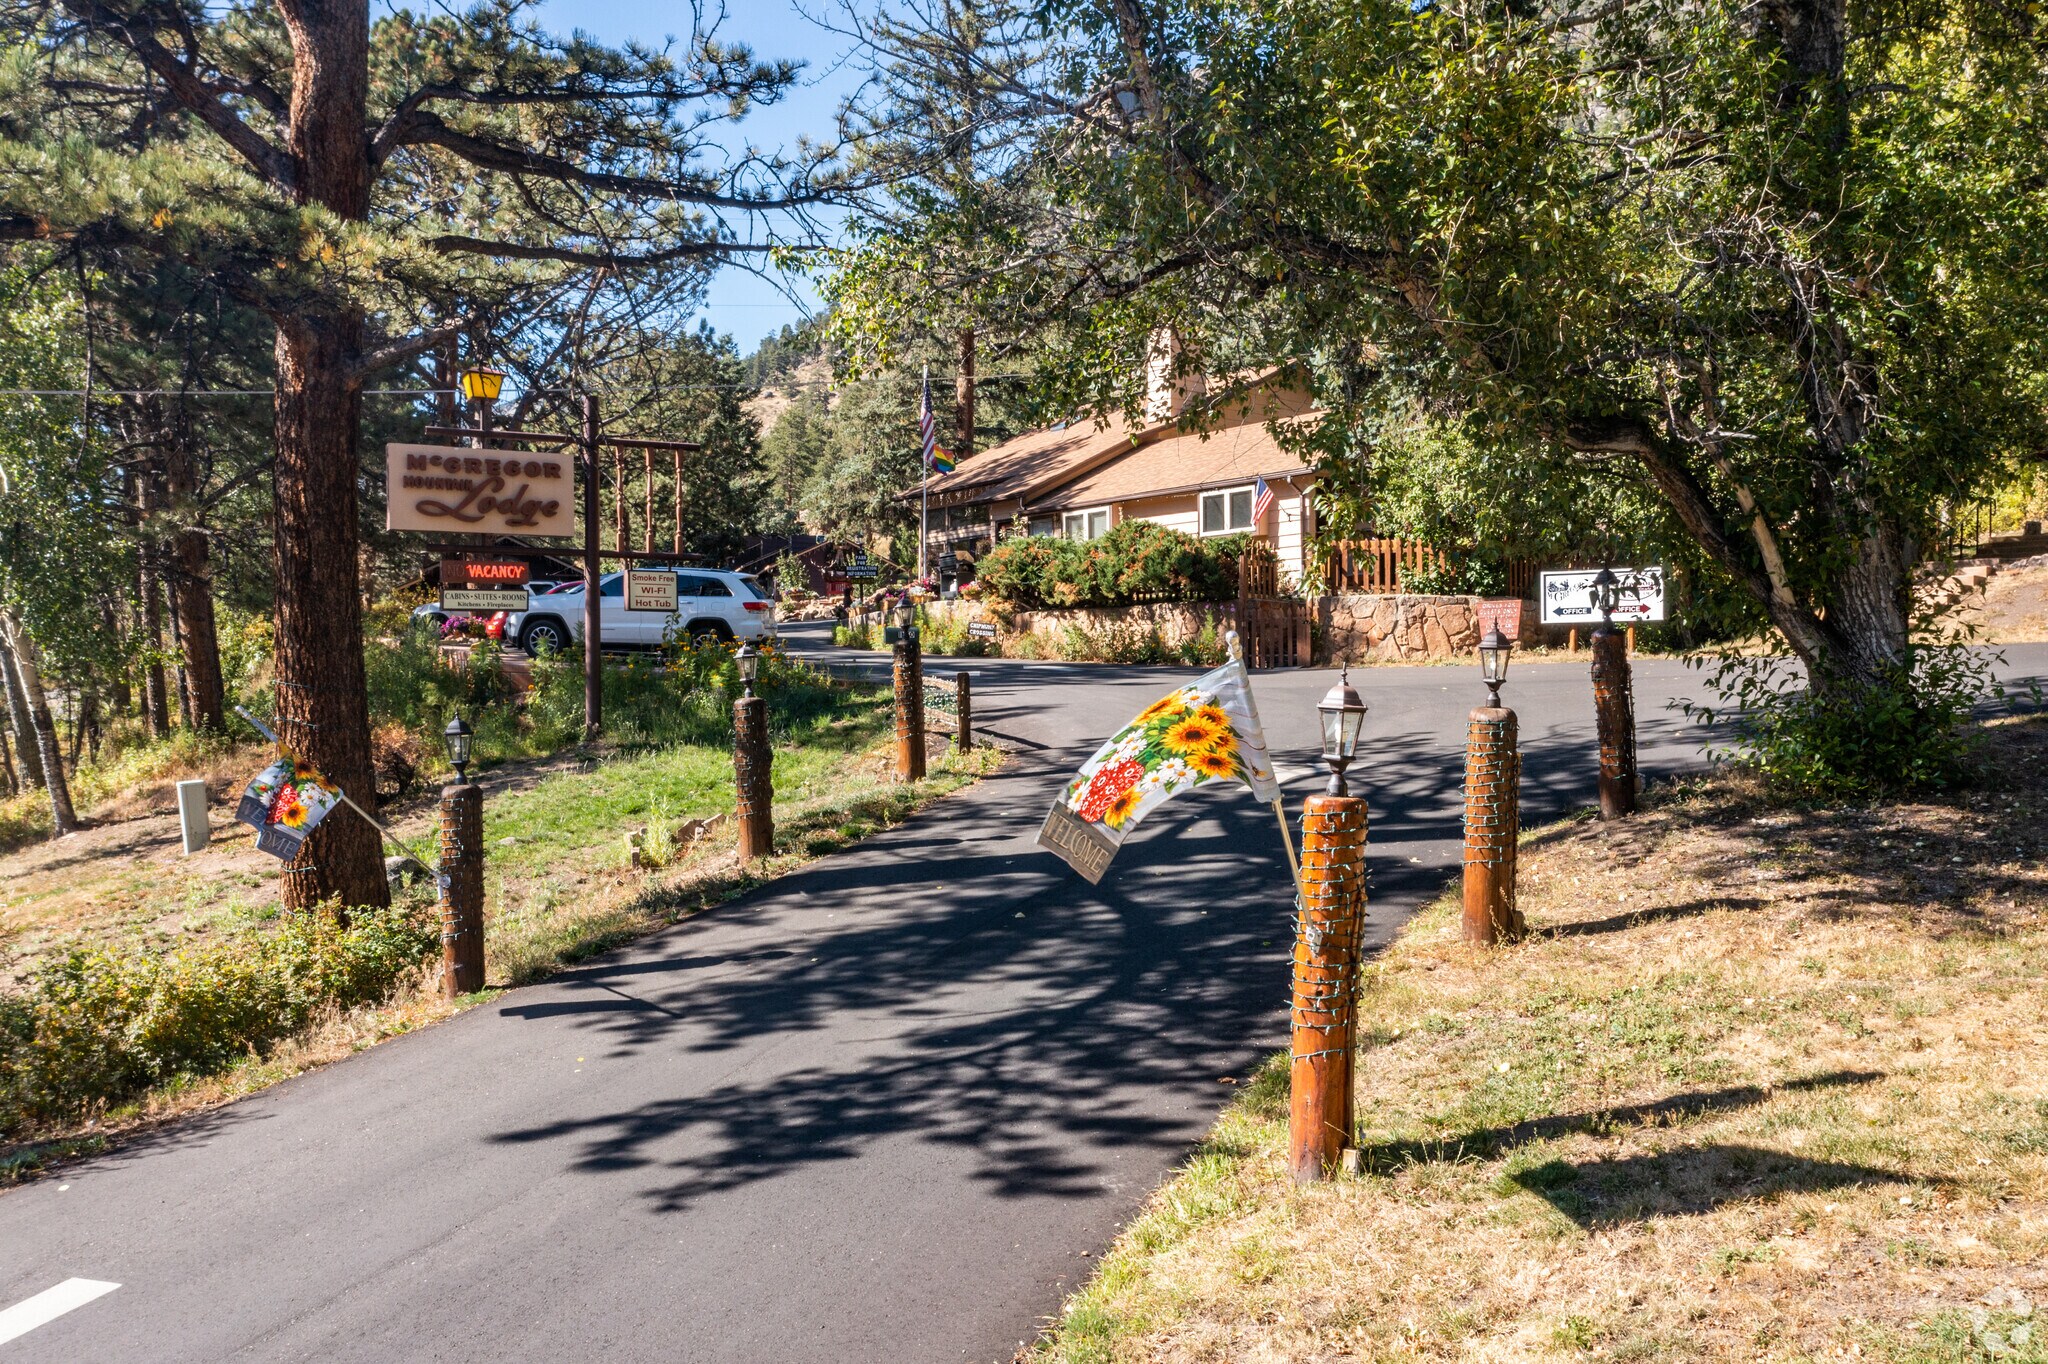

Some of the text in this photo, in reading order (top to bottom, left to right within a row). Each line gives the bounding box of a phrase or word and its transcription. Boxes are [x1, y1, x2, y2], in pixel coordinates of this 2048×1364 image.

[403, 475, 474, 492] MOUNTAIN
[415, 476, 560, 527] Lodge
[465, 564, 525, 578] VACANCY
[632, 574, 657, 582] Smoke
[445, 592, 470, 600] CABINS
[474, 593, 497, 601] SUITES
[635, 599, 652, 607] Hot
[970, 629, 994, 637] CROSSING
[1042, 811, 1109, 874] WELCOME
